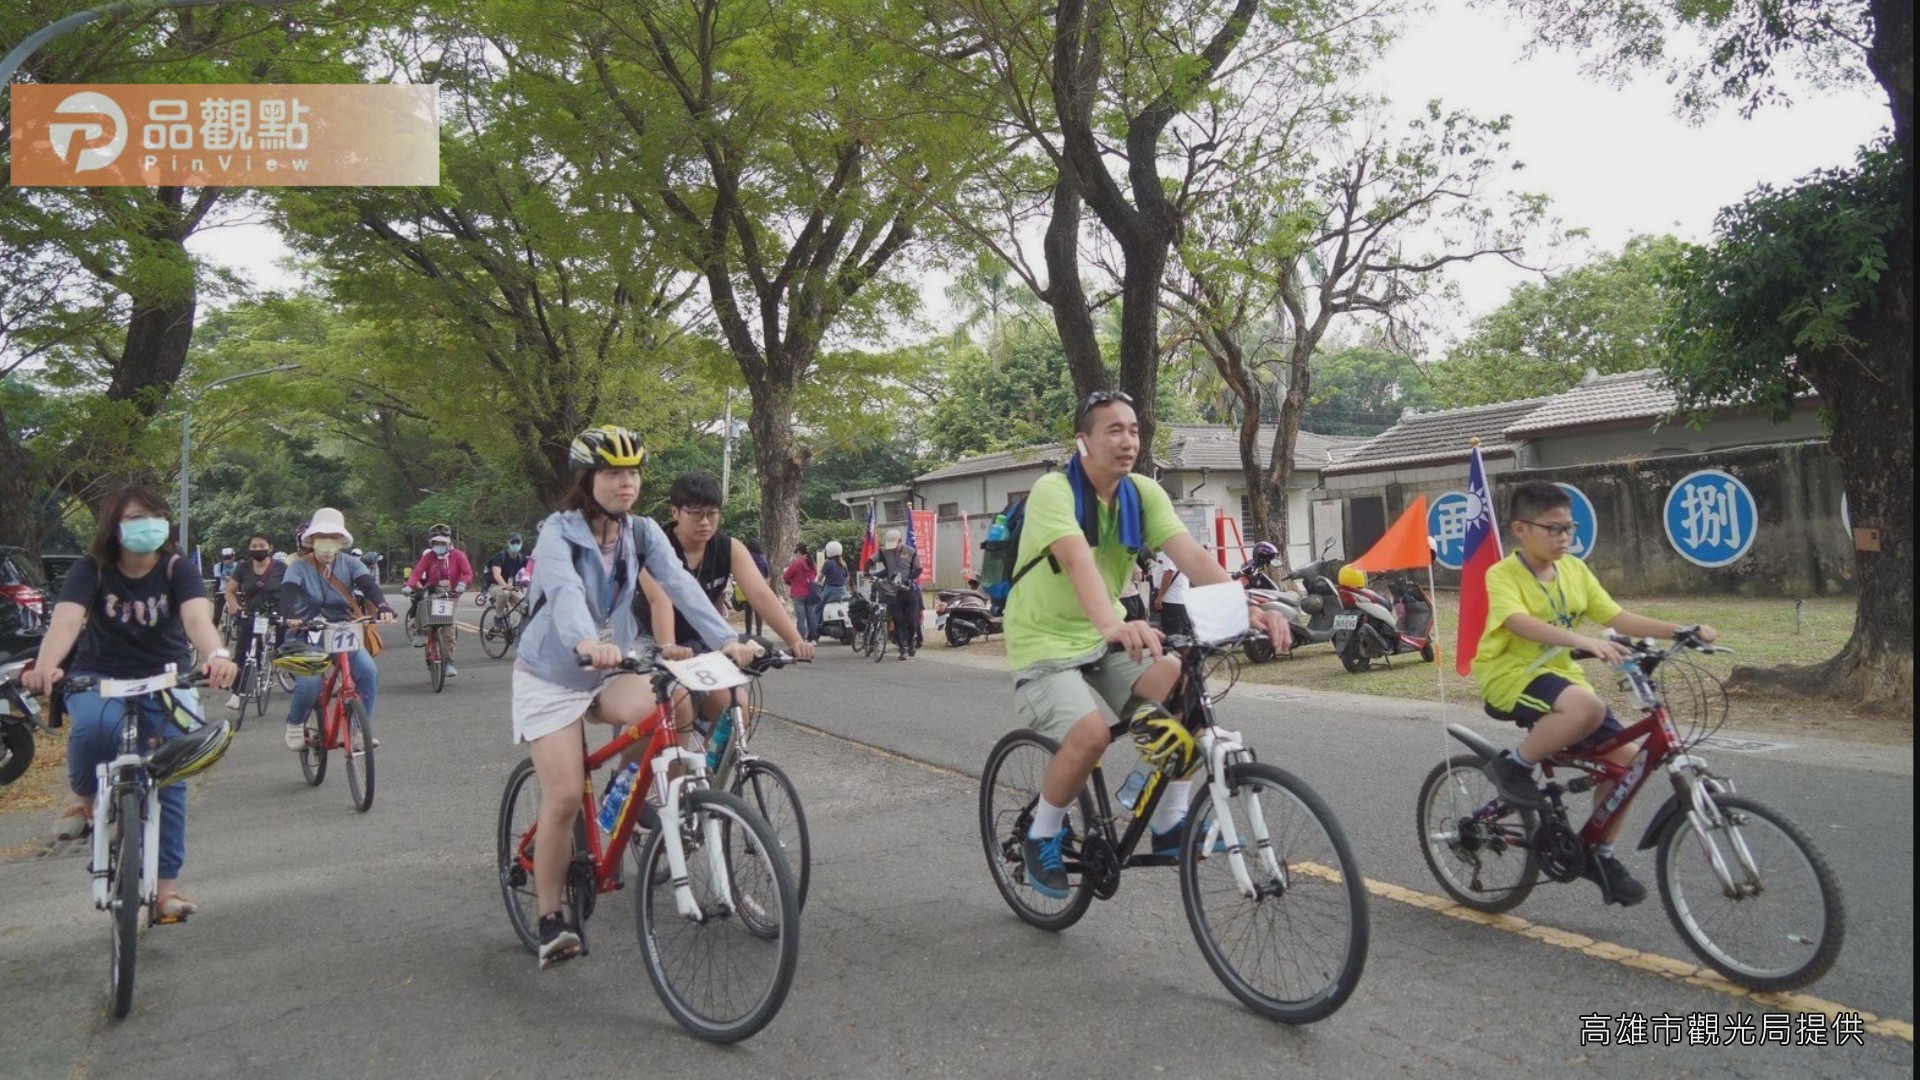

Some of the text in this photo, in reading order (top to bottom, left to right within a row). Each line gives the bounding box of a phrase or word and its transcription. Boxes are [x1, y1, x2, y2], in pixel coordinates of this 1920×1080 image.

[1680, 481, 1741, 549] 捌
[438, 604, 446, 614] 3
[334, 632, 355, 649] 11
[695, 670, 718, 686] 8
